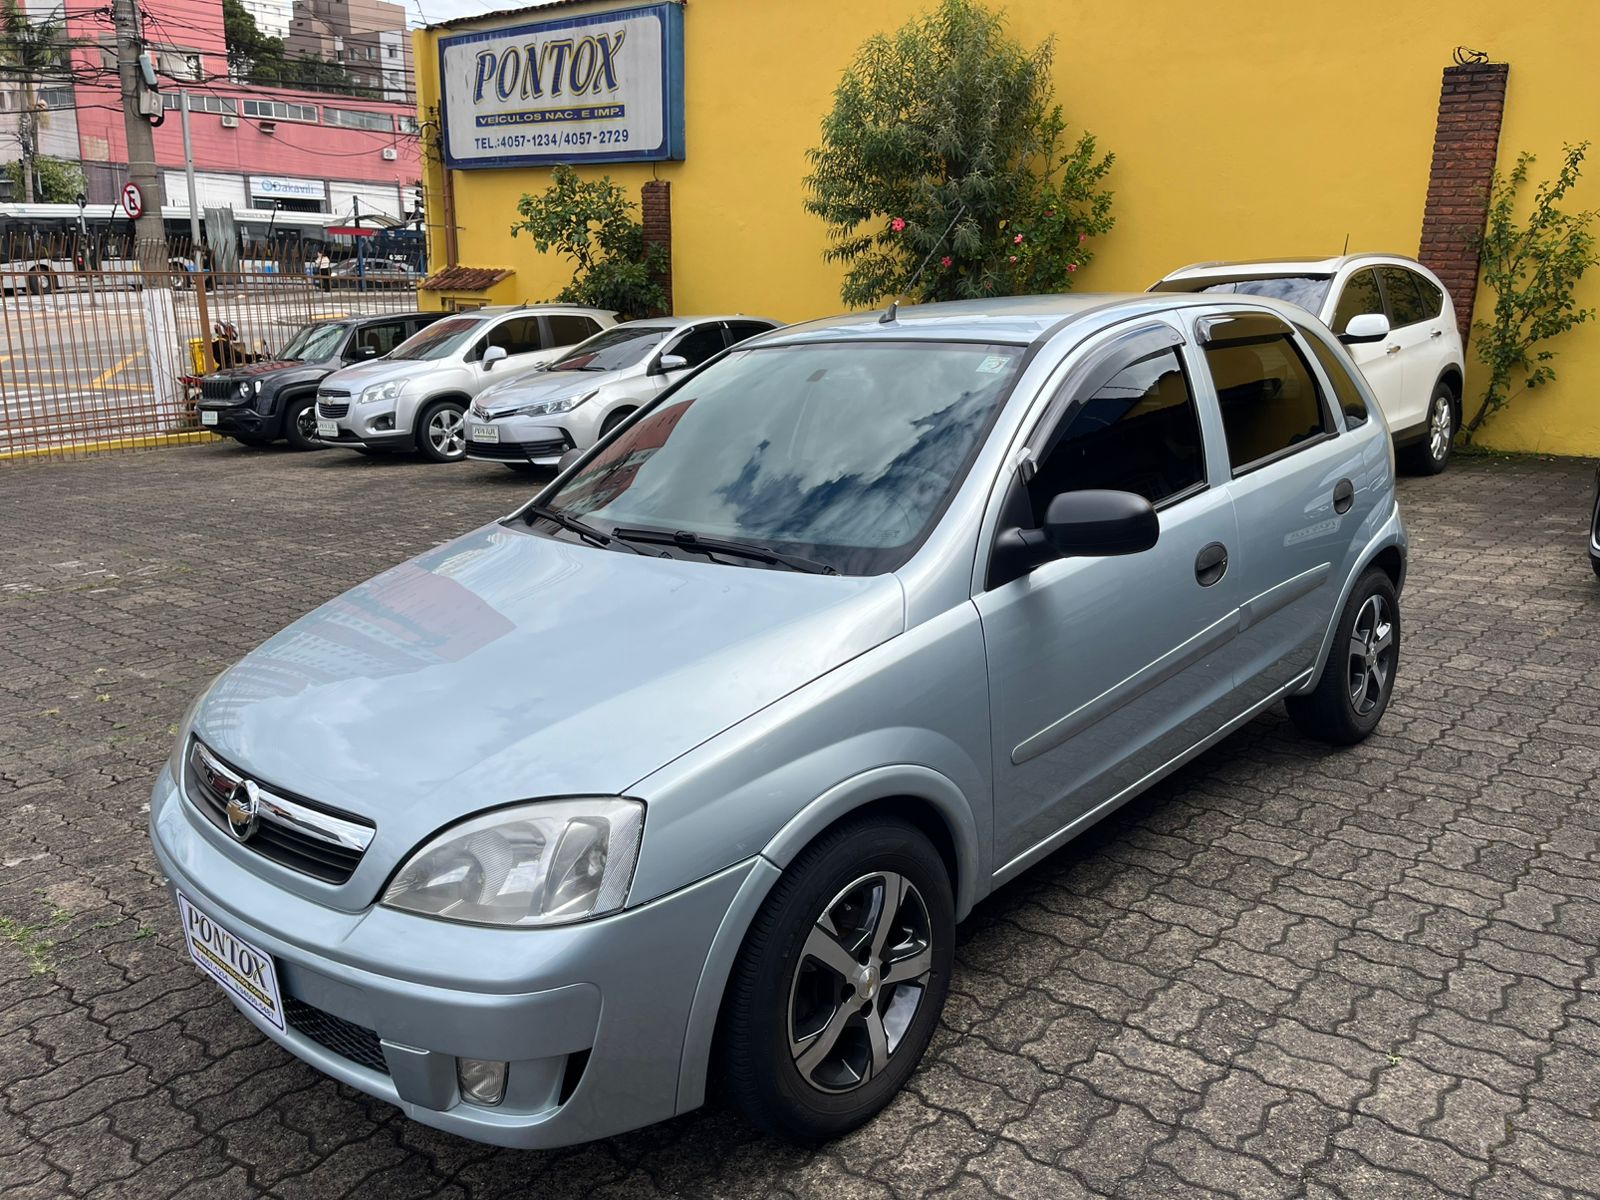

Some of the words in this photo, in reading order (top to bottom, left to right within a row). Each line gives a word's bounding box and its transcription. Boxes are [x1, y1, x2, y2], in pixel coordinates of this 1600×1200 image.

[474, 31, 625, 104] PONTOX
[545, 111, 577, 120] NAC.
[581, 109, 590, 118] E
[594, 107, 622, 117] IMP.
[187, 904, 269, 991] PONTOX
